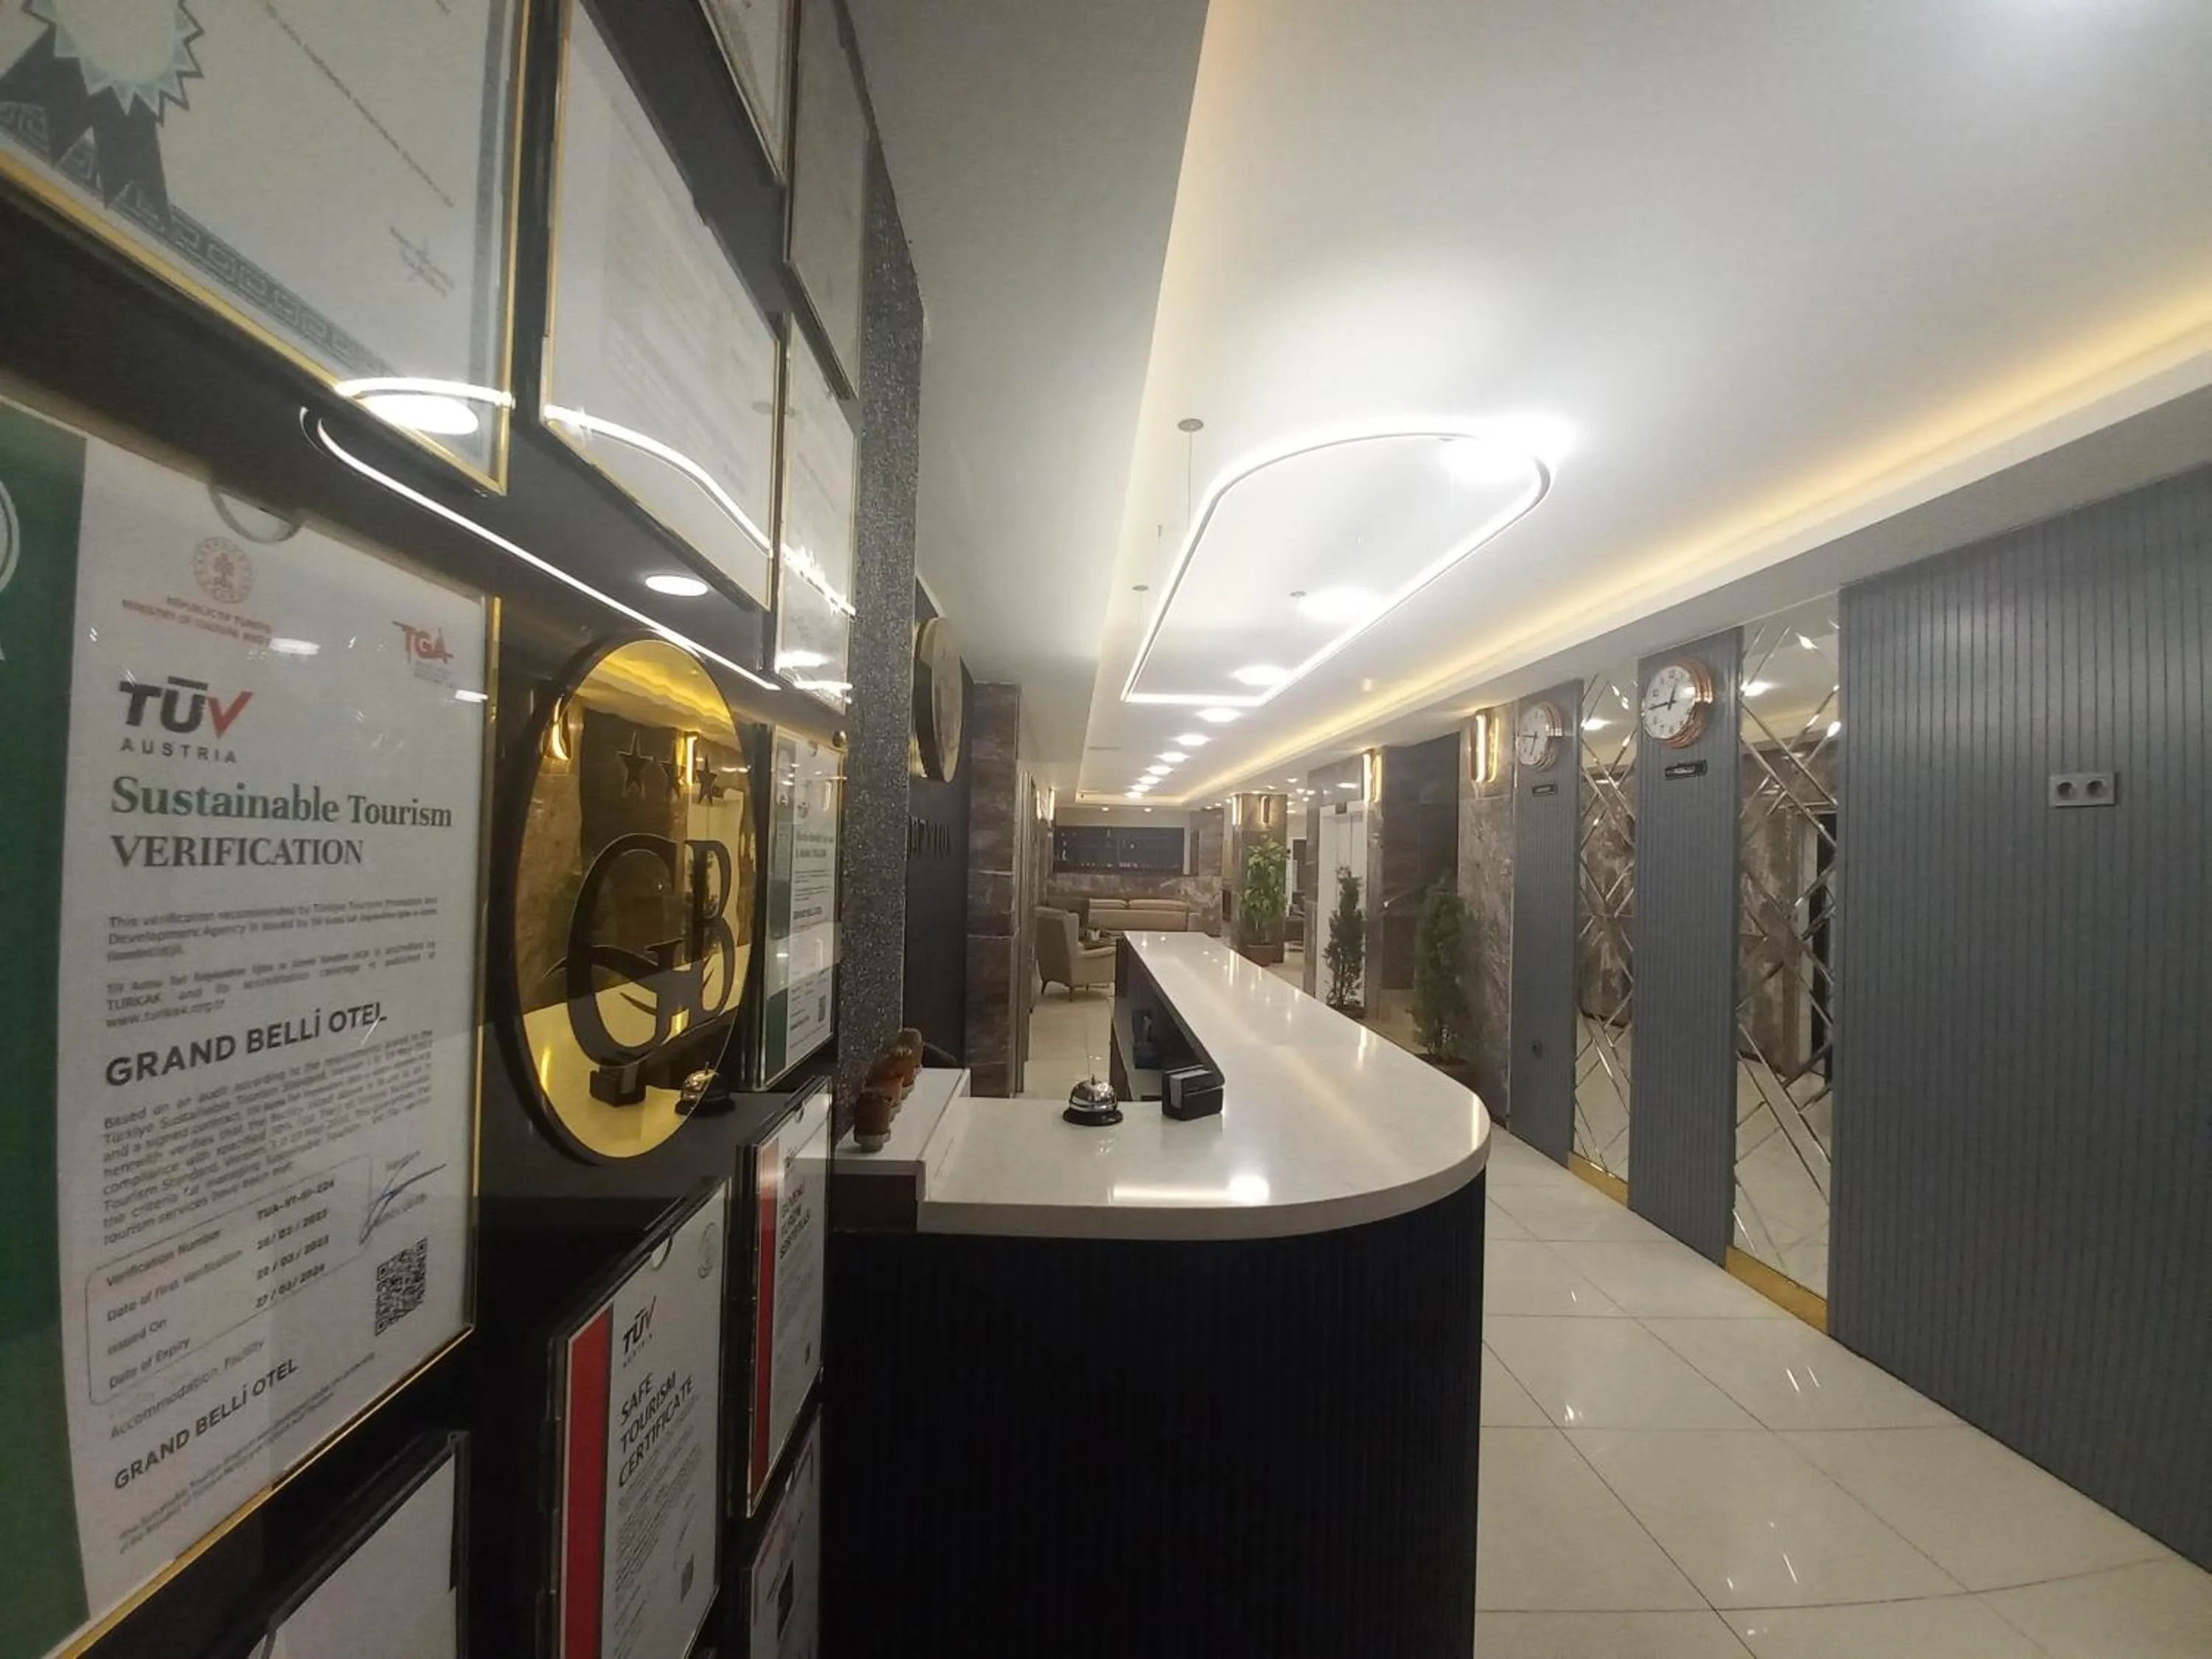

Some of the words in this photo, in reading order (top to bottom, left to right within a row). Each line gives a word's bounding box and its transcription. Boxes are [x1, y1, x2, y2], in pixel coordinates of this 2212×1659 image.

[120, 738, 237, 764] AUSTRIA
[111, 775, 339, 824] Sustainable
[347, 794, 452, 828] Tourism
[111, 834, 364, 868] VERIFICATION
[105, 1035, 236, 1087] GRAND
[246, 1008, 321, 1054] BELLİ
[328, 1001, 388, 1034] OTEL
[111, 1368, 218, 1439] Accommodation
[114, 1429, 189, 1489] GRAND
[195, 1384, 247, 1436] BELLİ
[252, 1359, 298, 1397] OTEL
[618, 1374, 693, 1487] CERTIFICATE
[620, 1370, 676, 1453] TOURISM
[621, 1371, 653, 1426] SAFE
